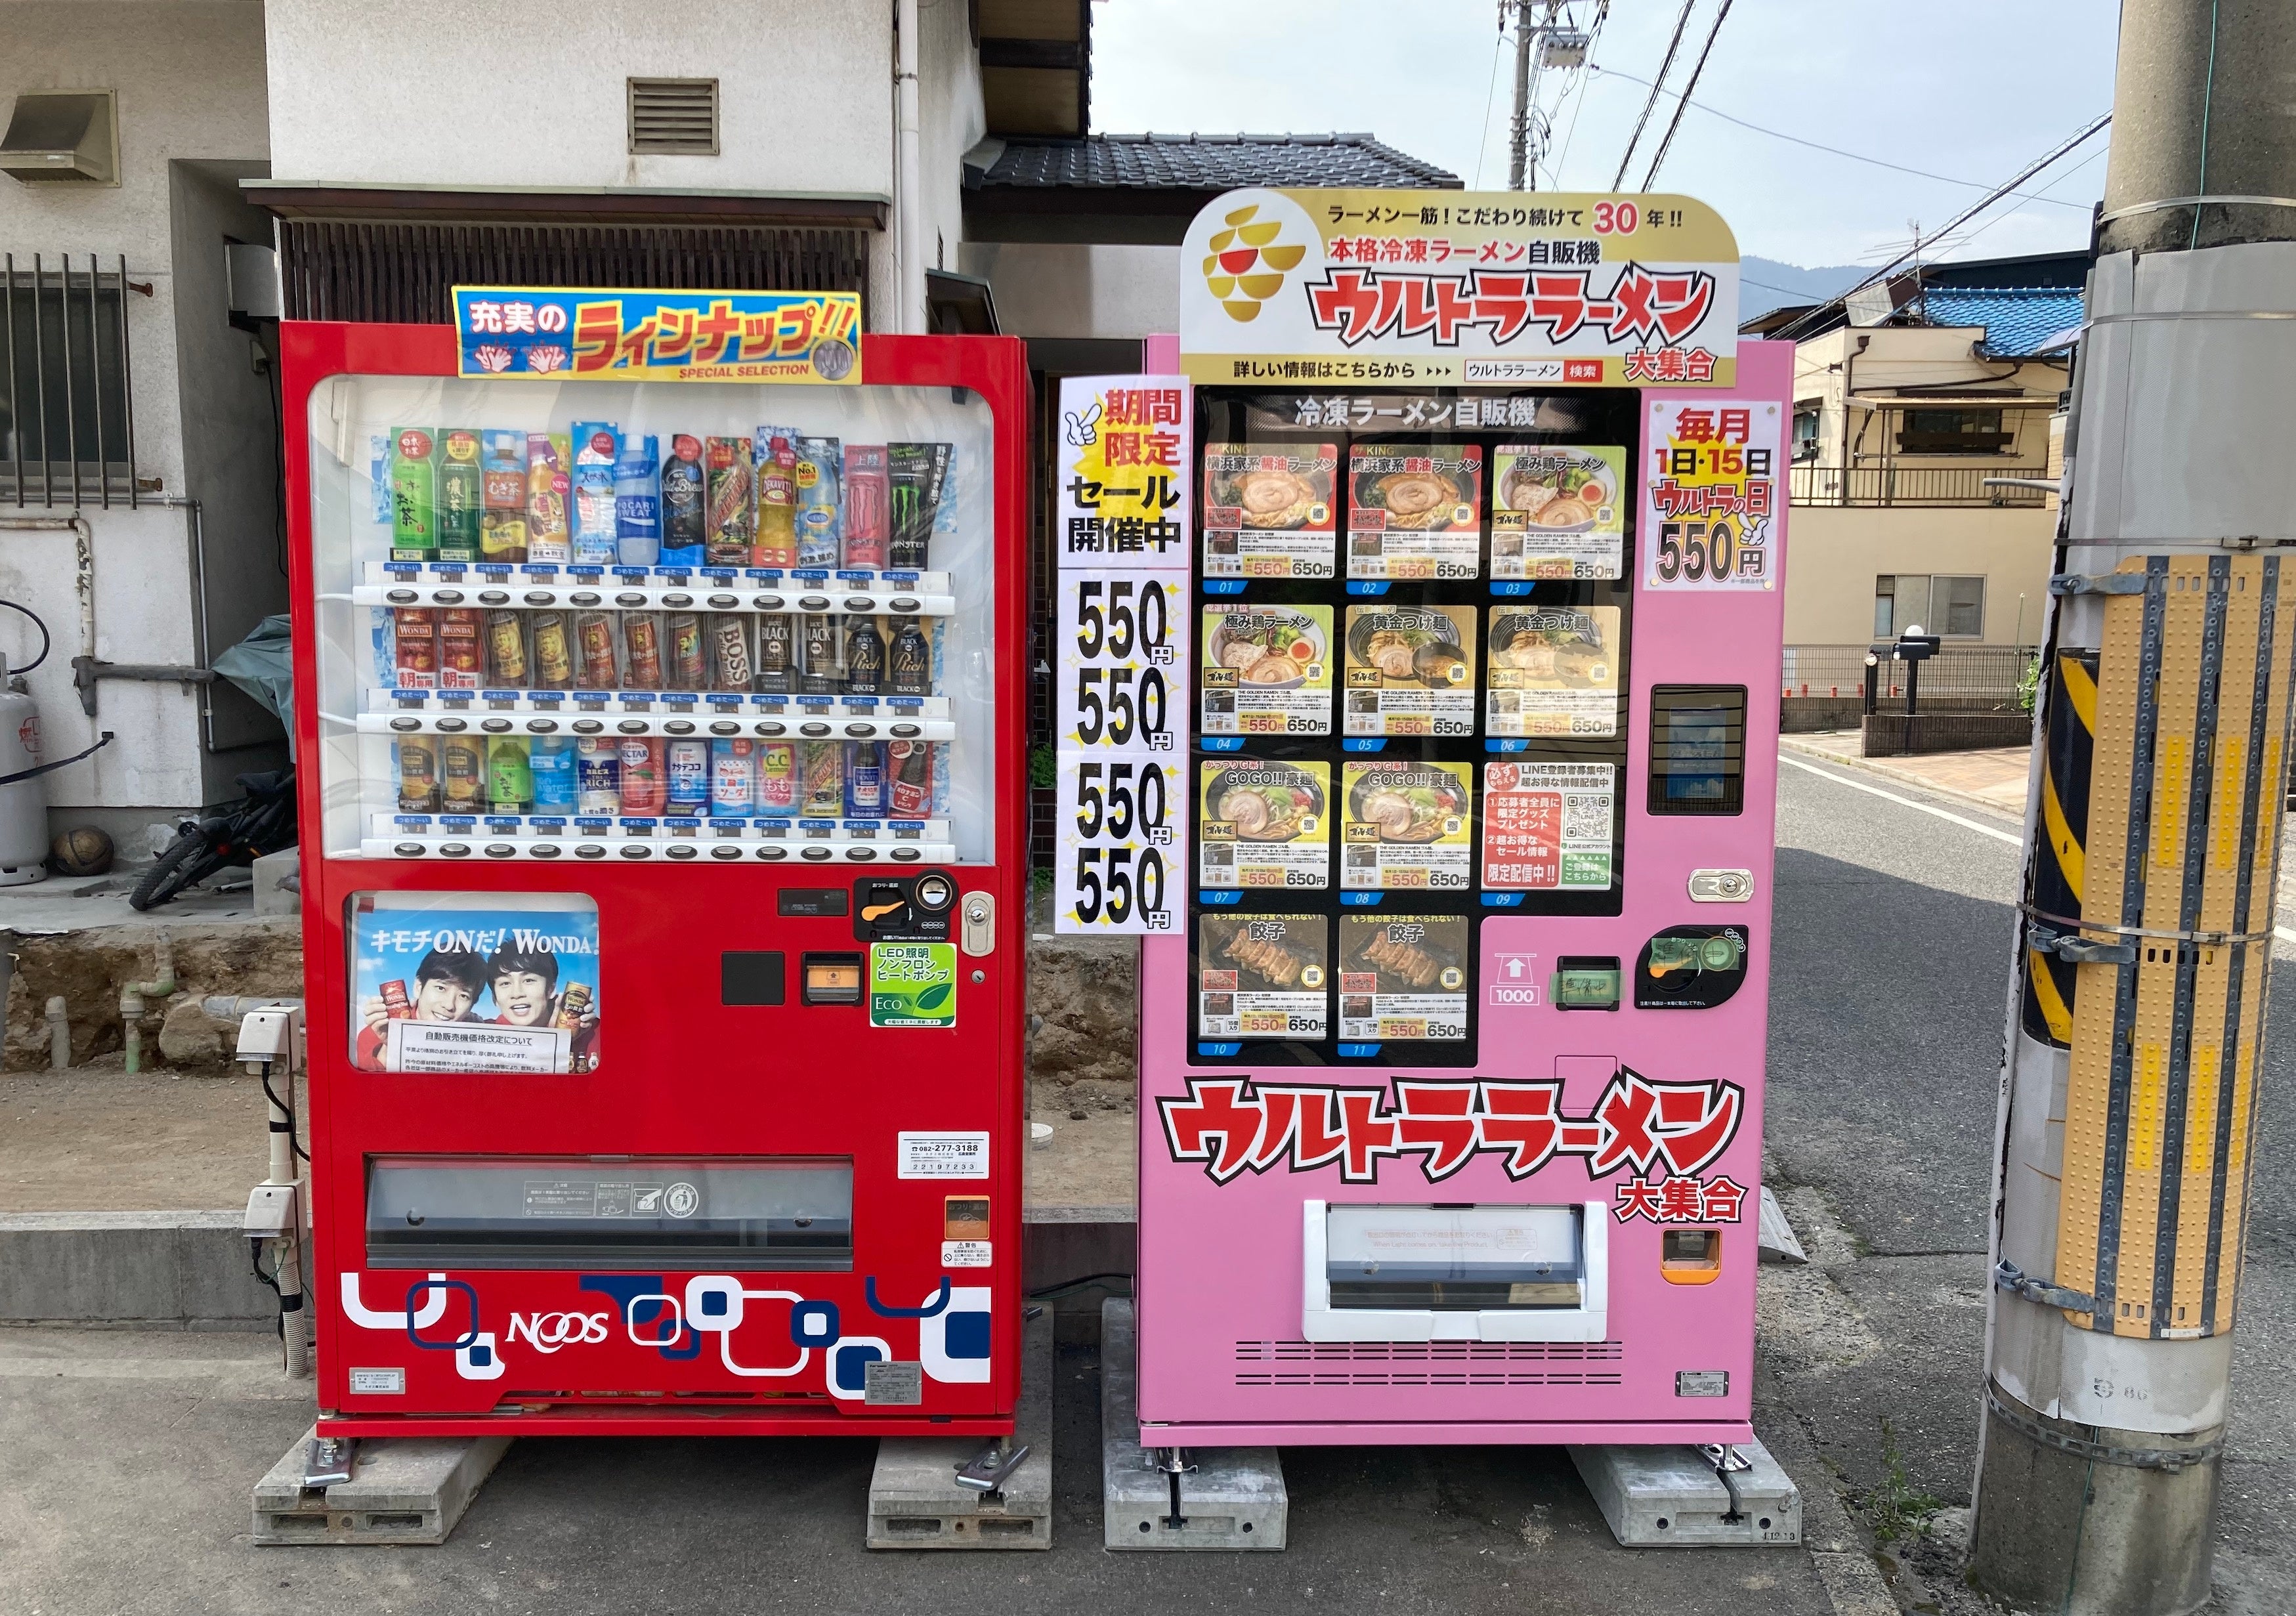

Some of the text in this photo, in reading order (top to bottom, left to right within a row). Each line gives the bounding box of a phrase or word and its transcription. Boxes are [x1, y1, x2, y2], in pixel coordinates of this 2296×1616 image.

[1592, 201, 1639, 235] 30
[1329, 238, 1601, 265] 本格冷凍ラーメン自販機
[1304, 261, 1716, 348] ウルトララーメン
[469, 301, 567, 333] 充実の
[679, 364, 809, 379] SPECIAL SELECTION
[1233, 360, 1597, 380] 詳しい情報はこちらから ウルトララーメン 検索
[1624, 346, 1717, 383] 大集合
[1105, 389, 1181, 426] 期間
[1294, 397, 1536, 427] 冷凍ラーメン自販機
[1676, 408, 1750, 444] 毎月
[1105, 432, 1180, 467] 限定
[1367, 446, 1395, 456] KING
[856, 454, 879, 466] 上陸
[1206, 456, 1336, 472] 横浜家系醤油ラーメン
[1351, 457, 1481, 473] 横浜家系醤油ラーメン
[1515, 457, 1605, 471] 極み鶏ラーメン
[551, 480, 569, 489] NEW
[1067, 476, 1181, 509] セール
[1651, 479, 1772, 519] ウルトラの日
[1068, 516, 1181, 553] 開催中
[1656, 521, 1766, 583] 550円
[1292, 563, 1332, 575] 650円
[1437, 565, 1476, 577] 650円
[1575, 566, 1614, 578] 650円
[1220, 582, 1233, 593] 01
[1362, 583, 1377, 593] 02
[1506, 584, 1520, 593] 03
[1077, 580, 1174, 665] 550円
[1225, 614, 1314, 629] 極み鶏ラーメン
[1373, 615, 1449, 631] 黄金つけ麺
[1515, 616, 1590, 631] 黄金つけ麺
[399, 625, 429, 635] WONDA
[442, 625, 472, 635] WONDA
[761, 627, 789, 641] BLACK
[724, 626, 748, 685] BOSS
[851, 651, 881, 670] Rich
[895, 652, 925, 671] Rich
[399, 672, 415, 687] 朝
[442, 672, 457, 687] 朝
[1076, 667, 1174, 751] 550円
[1287, 719, 1327, 731] 650円
[1434, 722, 1473, 734] 650円
[1572, 721, 1612, 733] 650円
[1216, 739, 1231, 749] 04
[1358, 740, 1372, 750] 05
[1501, 740, 1515, 750] 06
[671, 763, 701, 771] ナタデココ
[765, 778, 788, 792] もも
[1285, 772, 1314, 786] 豪麺
[1430, 773, 1458, 787] 豪麺
[1521, 778, 1609, 788] 超お得な情報配信中
[1076, 762, 1172, 845] 550円
[1497, 809, 1549, 819] 限定グッズ
[1497, 820, 1548, 830] プレゼント
[1496, 846, 1548, 857] セール情報
[1286, 874, 1326, 885] 650円
[1430, 874, 1469, 886] 650円
[1565, 872, 1607, 881] こちらから
[1075, 847, 1170, 929] 550円
[1214, 893, 1229, 902] 07
[1355, 894, 1369, 904] 08
[1496, 895, 1510, 904] 09
[1250, 921, 1286, 941] 餃子
[1388, 924, 1424, 943] 餃子
[878, 948, 929, 958] LED照明
[878, 960, 935, 969] ノンフロン
[878, 970, 949, 981] ヒートポンプ
[1496, 989, 1534, 1002] 1000
[425, 1031, 532, 1046] 自動販売機価格改定について
[1214, 1045, 1227, 1054] 10
[1354, 1045, 1365, 1055] 11
[1155, 1065, 1745, 1186] ウルトララーメン
[1611, 1176, 1747, 1224] 大集合
